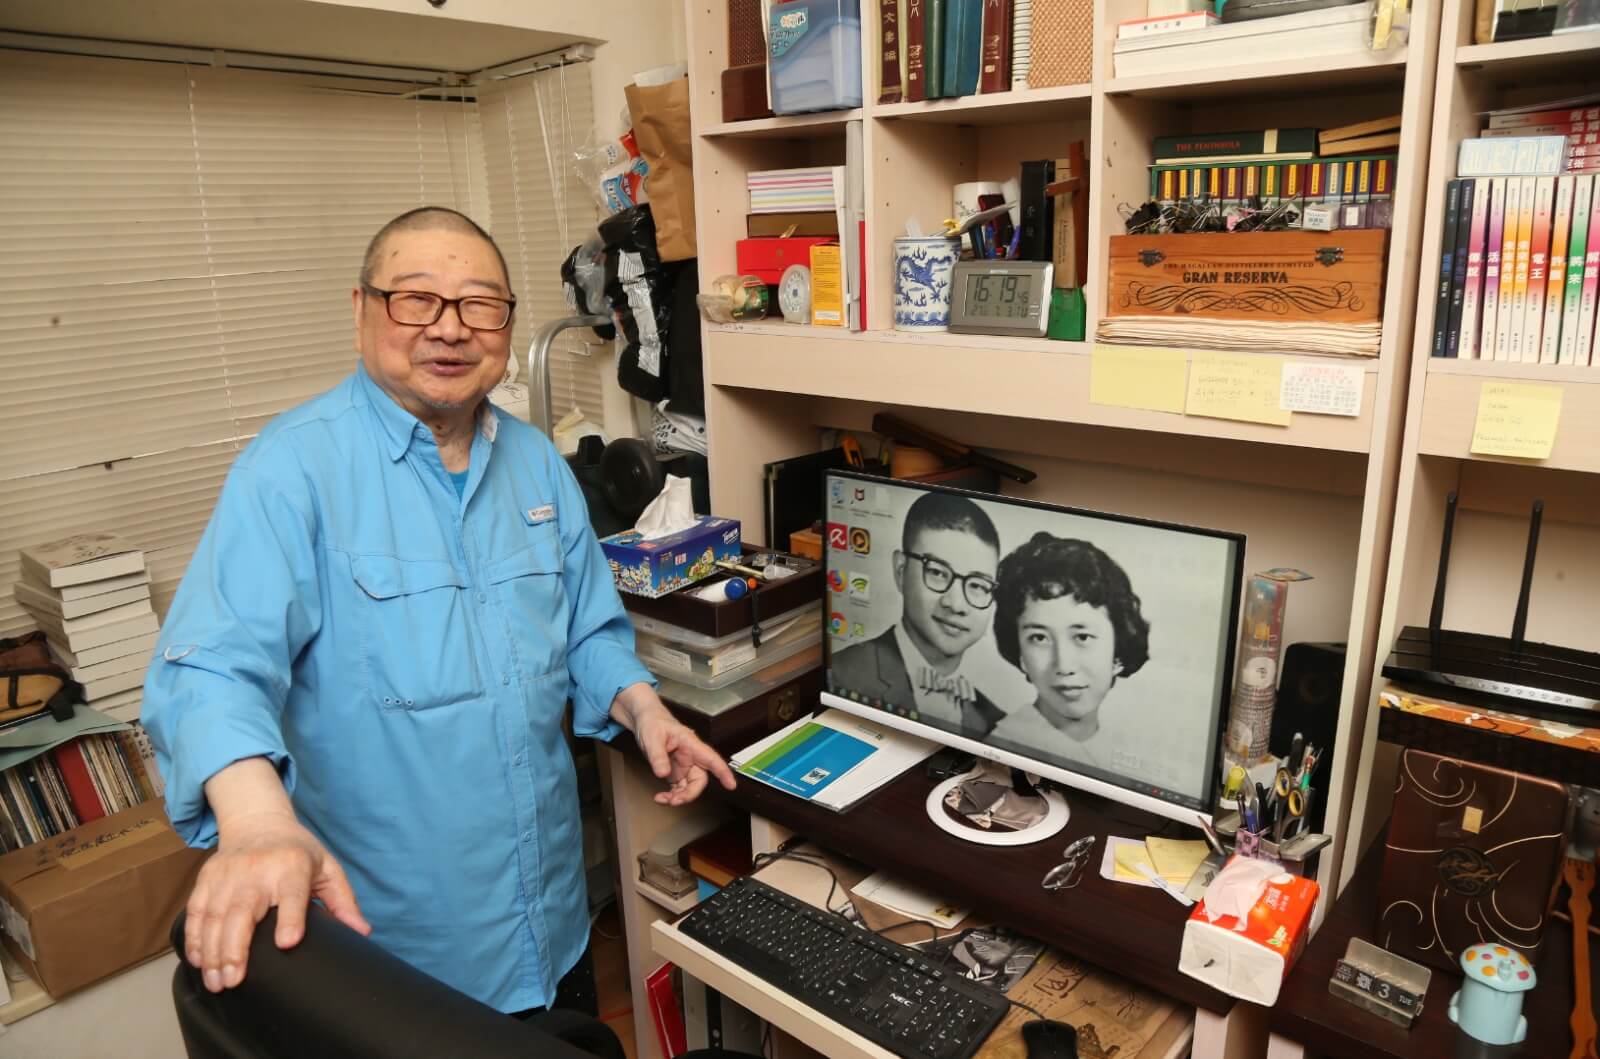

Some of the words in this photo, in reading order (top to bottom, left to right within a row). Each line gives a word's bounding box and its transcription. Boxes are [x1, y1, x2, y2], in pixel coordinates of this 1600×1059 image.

[1183, 272, 1219, 283] GRAN
[1224, 271, 1288, 283] RESERVA
[889, 992, 913, 1007] NEC
[1378, 983, 1391, 999] 3
[1398, 995, 1413, 1006] TUE
